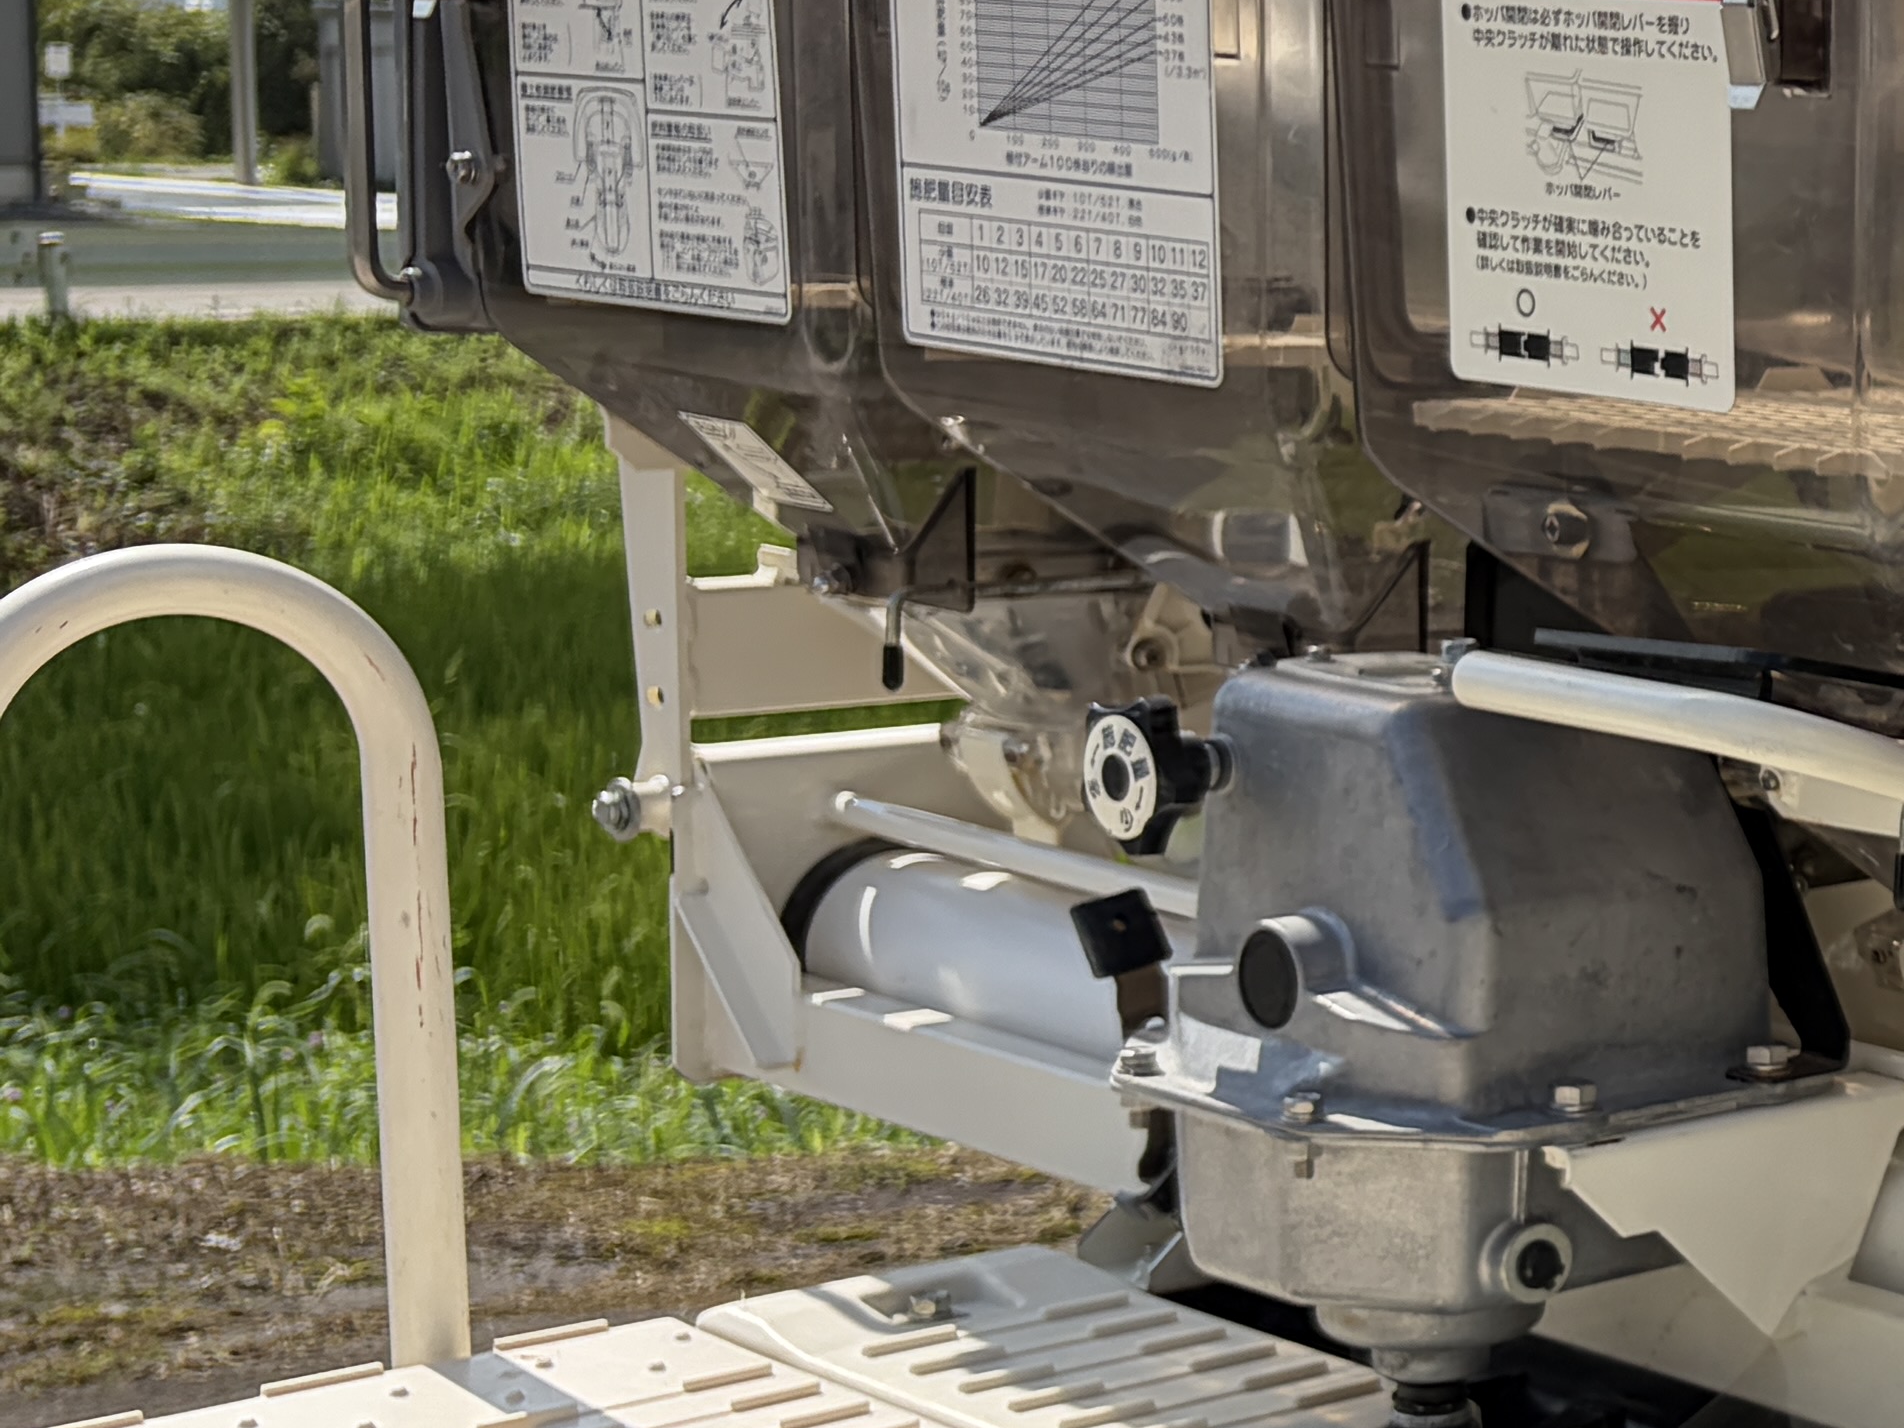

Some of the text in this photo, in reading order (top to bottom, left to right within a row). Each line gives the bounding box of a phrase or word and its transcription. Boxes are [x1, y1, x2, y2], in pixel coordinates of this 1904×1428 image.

[978, 225, 1206, 268] 1 2 3 4 5 6 7 8 9 10 11 12
[975, 254, 990, 274] 10
[993, 256, 1009, 277] 12
[1032, 261, 1048, 281] 17
[1051, 263, 1067, 284] 20
[1071, 265, 1087, 286] 22
[1090, 267, 1106, 289] 25
[1110, 270, 1126, 291] 27
[1130, 272, 1146, 293] 30
[1150, 275, 1166, 296] 32
[1170, 277, 1186, 298] 35
[1190, 279, 1207, 301] 37
[975, 285, 990, 305] 26
[994, 287, 1009, 307] 32
[1033, 292, 1048, 312] 45
[1052, 294, 1067, 315] 52
[1091, 299, 1107, 320] 64
[1111, 302, 1127, 322] 71
[1131, 304, 1147, 325] 77
[1151, 307, 1167, 328] 84
[1171, 309, 1187, 330] 90
